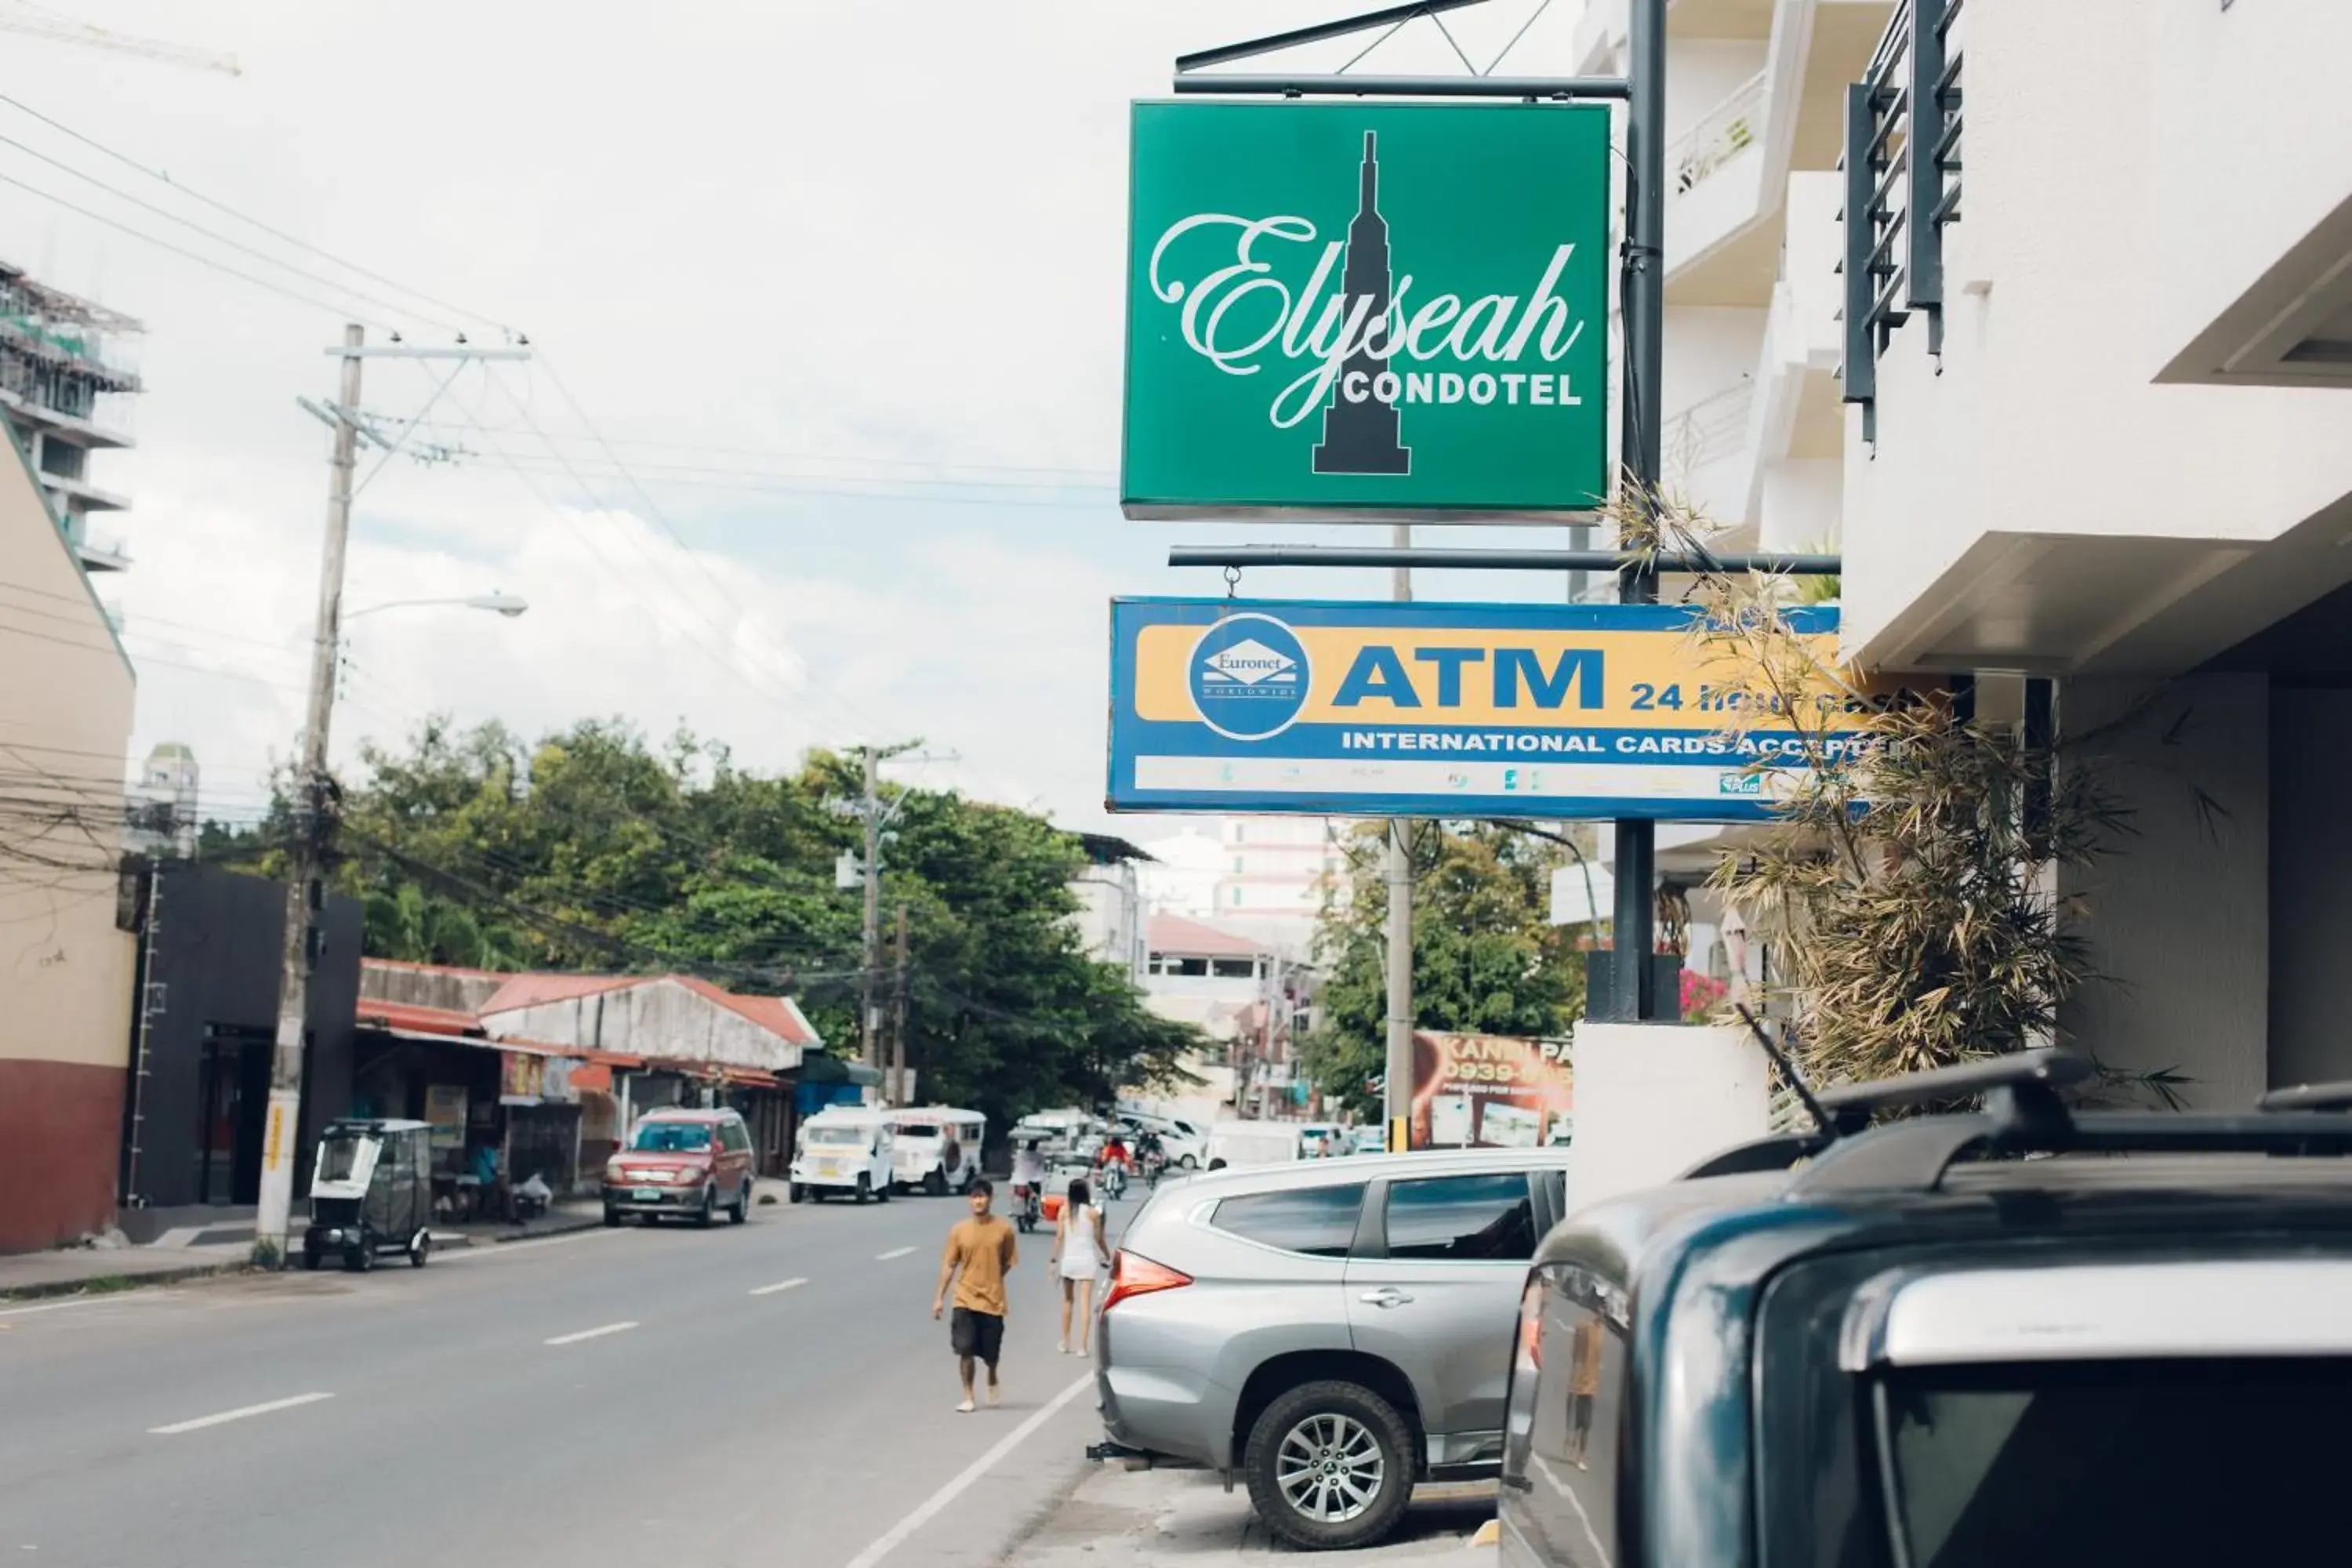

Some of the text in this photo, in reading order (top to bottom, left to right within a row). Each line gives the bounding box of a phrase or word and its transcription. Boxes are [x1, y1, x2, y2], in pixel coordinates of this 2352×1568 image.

[1149, 212, 1584, 429] Elyseah
[1343, 371, 1581, 405] CONDOTEL
[1219, 653, 1280, 670] Euronet
[1330, 645, 1604, 710] ATM
[1630, 683, 1682, 711] 24
[1700, 684, 1794, 713] hou
[1342, 731, 1606, 753] INTERNATIONAL
[1615, 736, 1726, 754] CARDS
